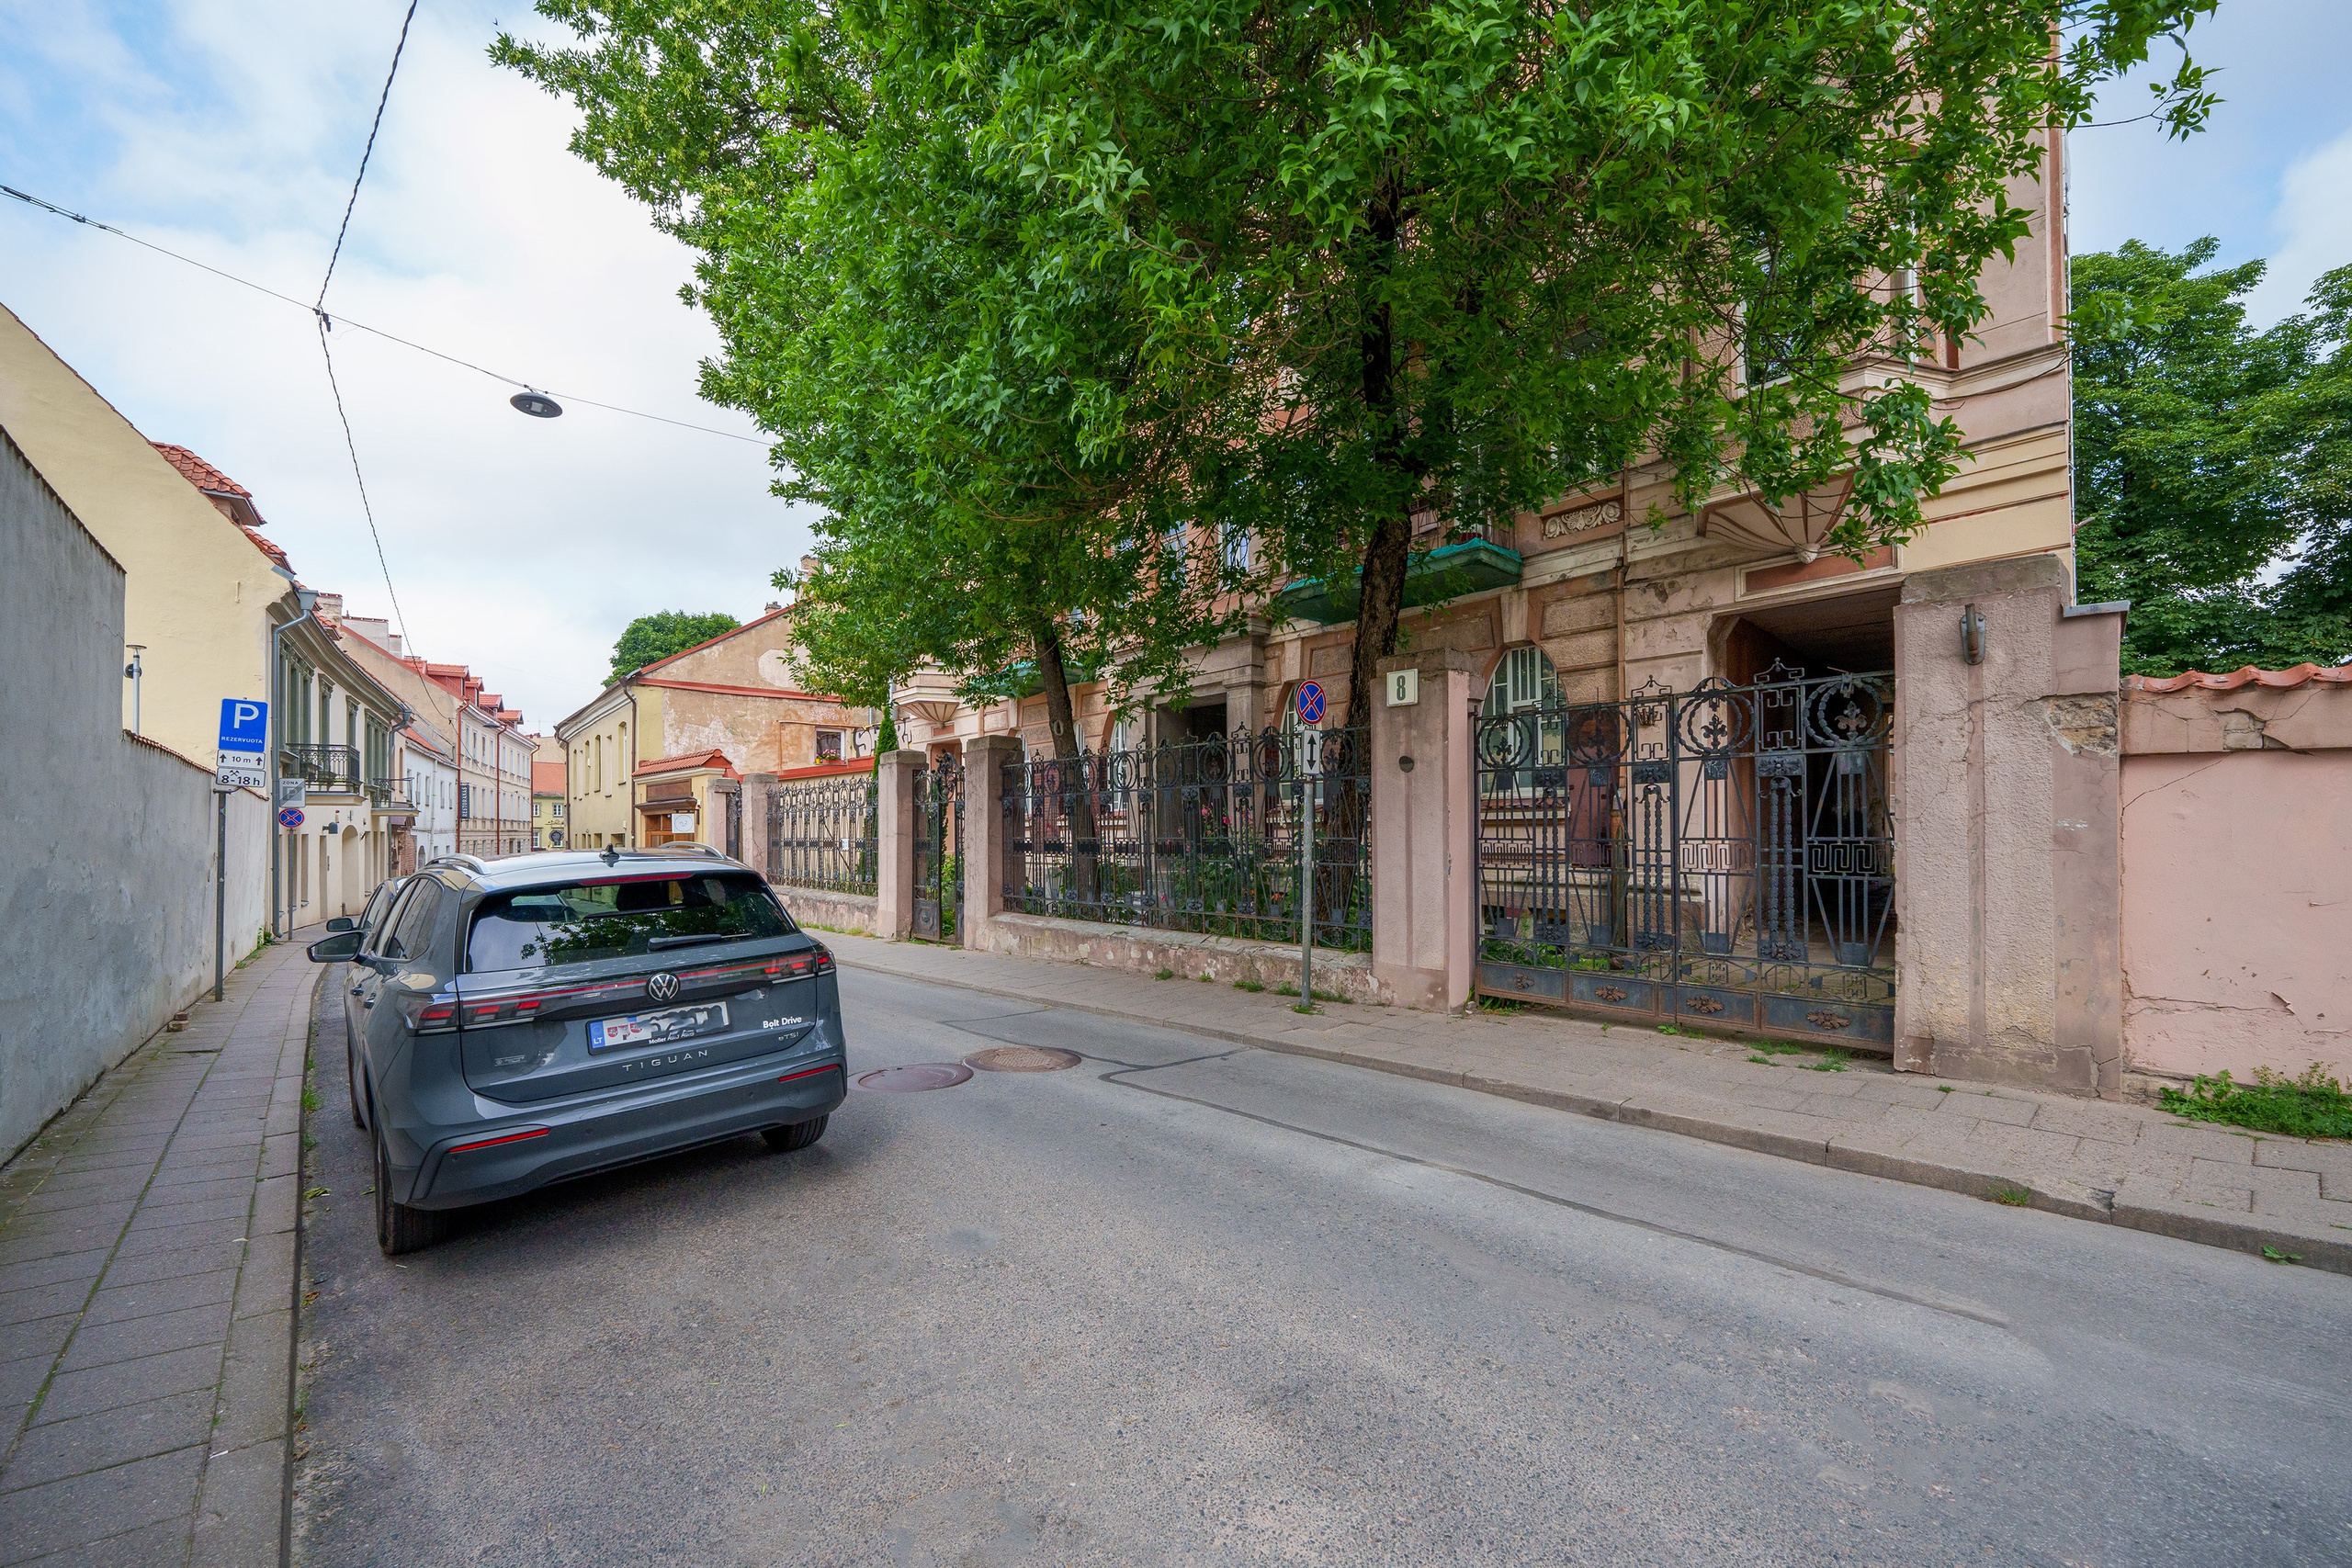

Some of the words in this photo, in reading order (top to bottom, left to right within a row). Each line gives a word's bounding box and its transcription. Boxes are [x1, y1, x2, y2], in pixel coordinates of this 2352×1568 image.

[1396, 675, 1406, 701] 8
[233, 703, 259, 728] P
[221, 775, 251, 785] 8-18
[253, 777, 260, 786] h
[287, 788, 297, 799] P
[763, 1019, 780, 1030] Bolt
[781, 1016, 802, 1026] Drive
[593, 1036, 603, 1045] LT
[622, 1049, 708, 1072] TIGUAN
